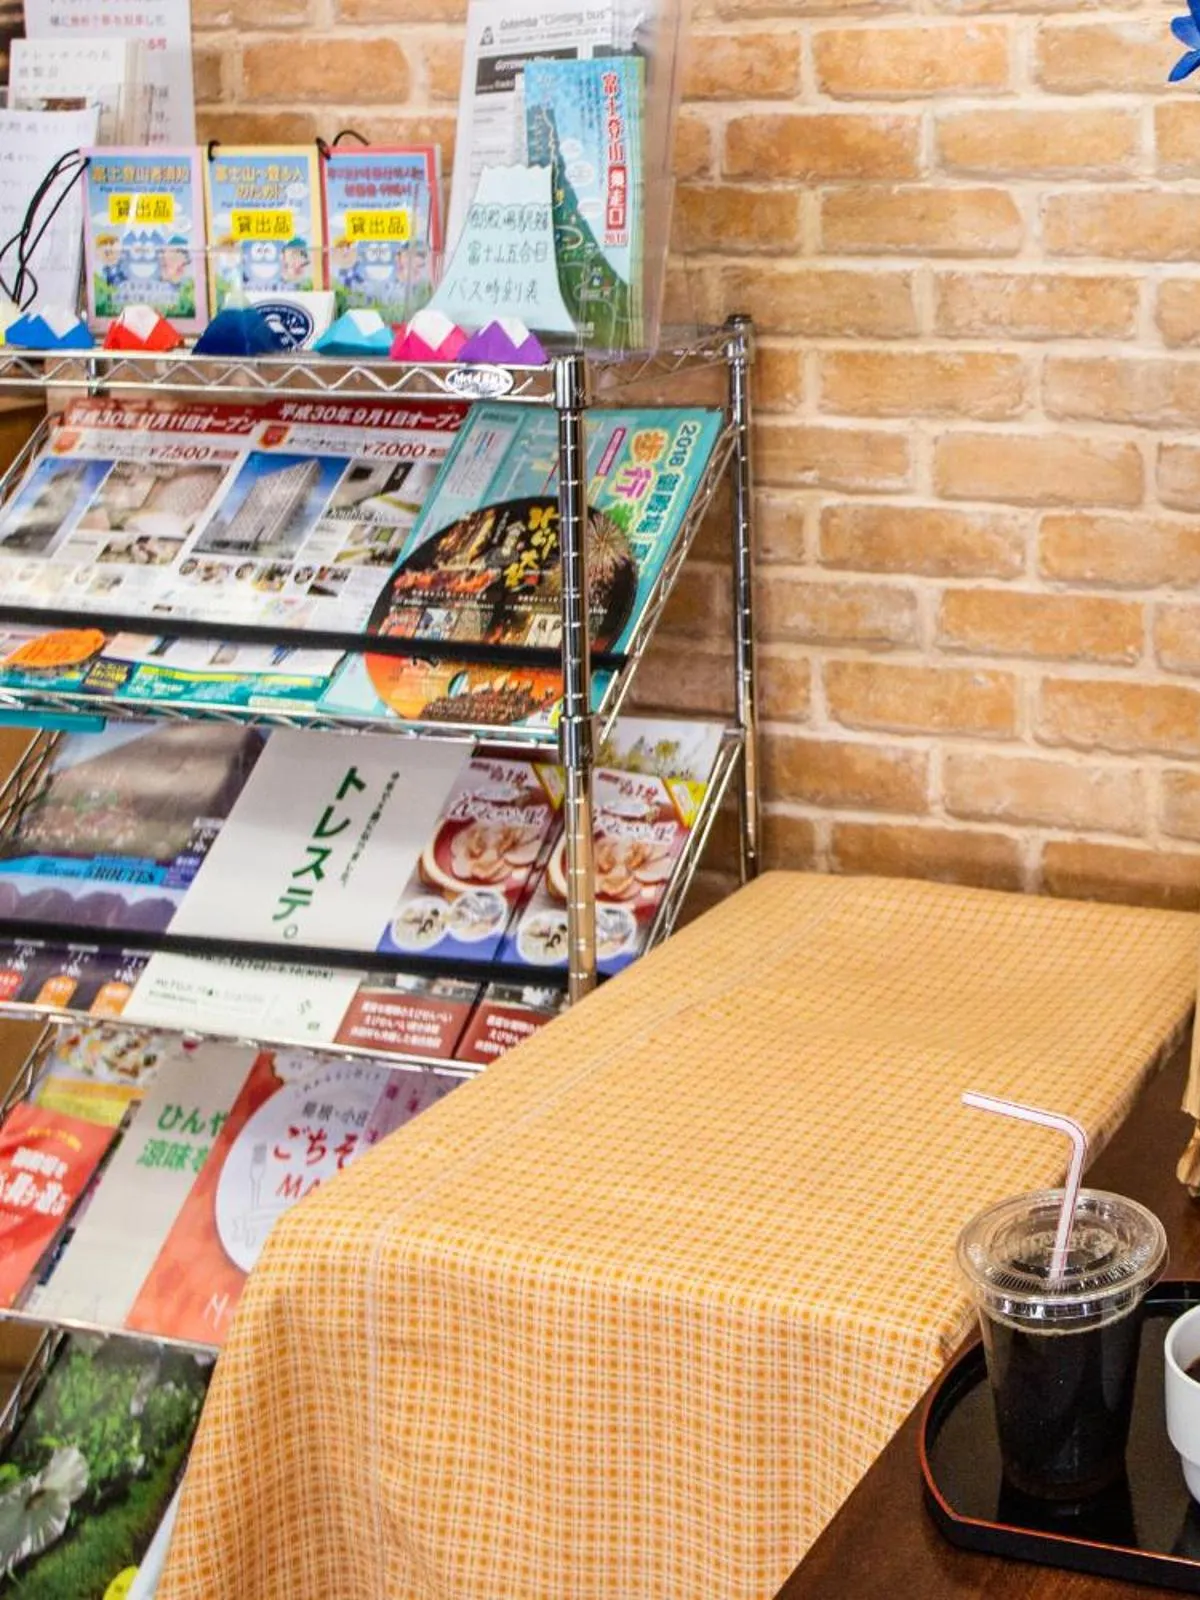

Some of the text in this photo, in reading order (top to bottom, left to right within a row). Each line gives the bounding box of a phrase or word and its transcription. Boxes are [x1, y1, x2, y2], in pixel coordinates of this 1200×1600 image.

[238, 215, 290, 233] 貸出品
[351, 216, 405, 234] 貸出品
